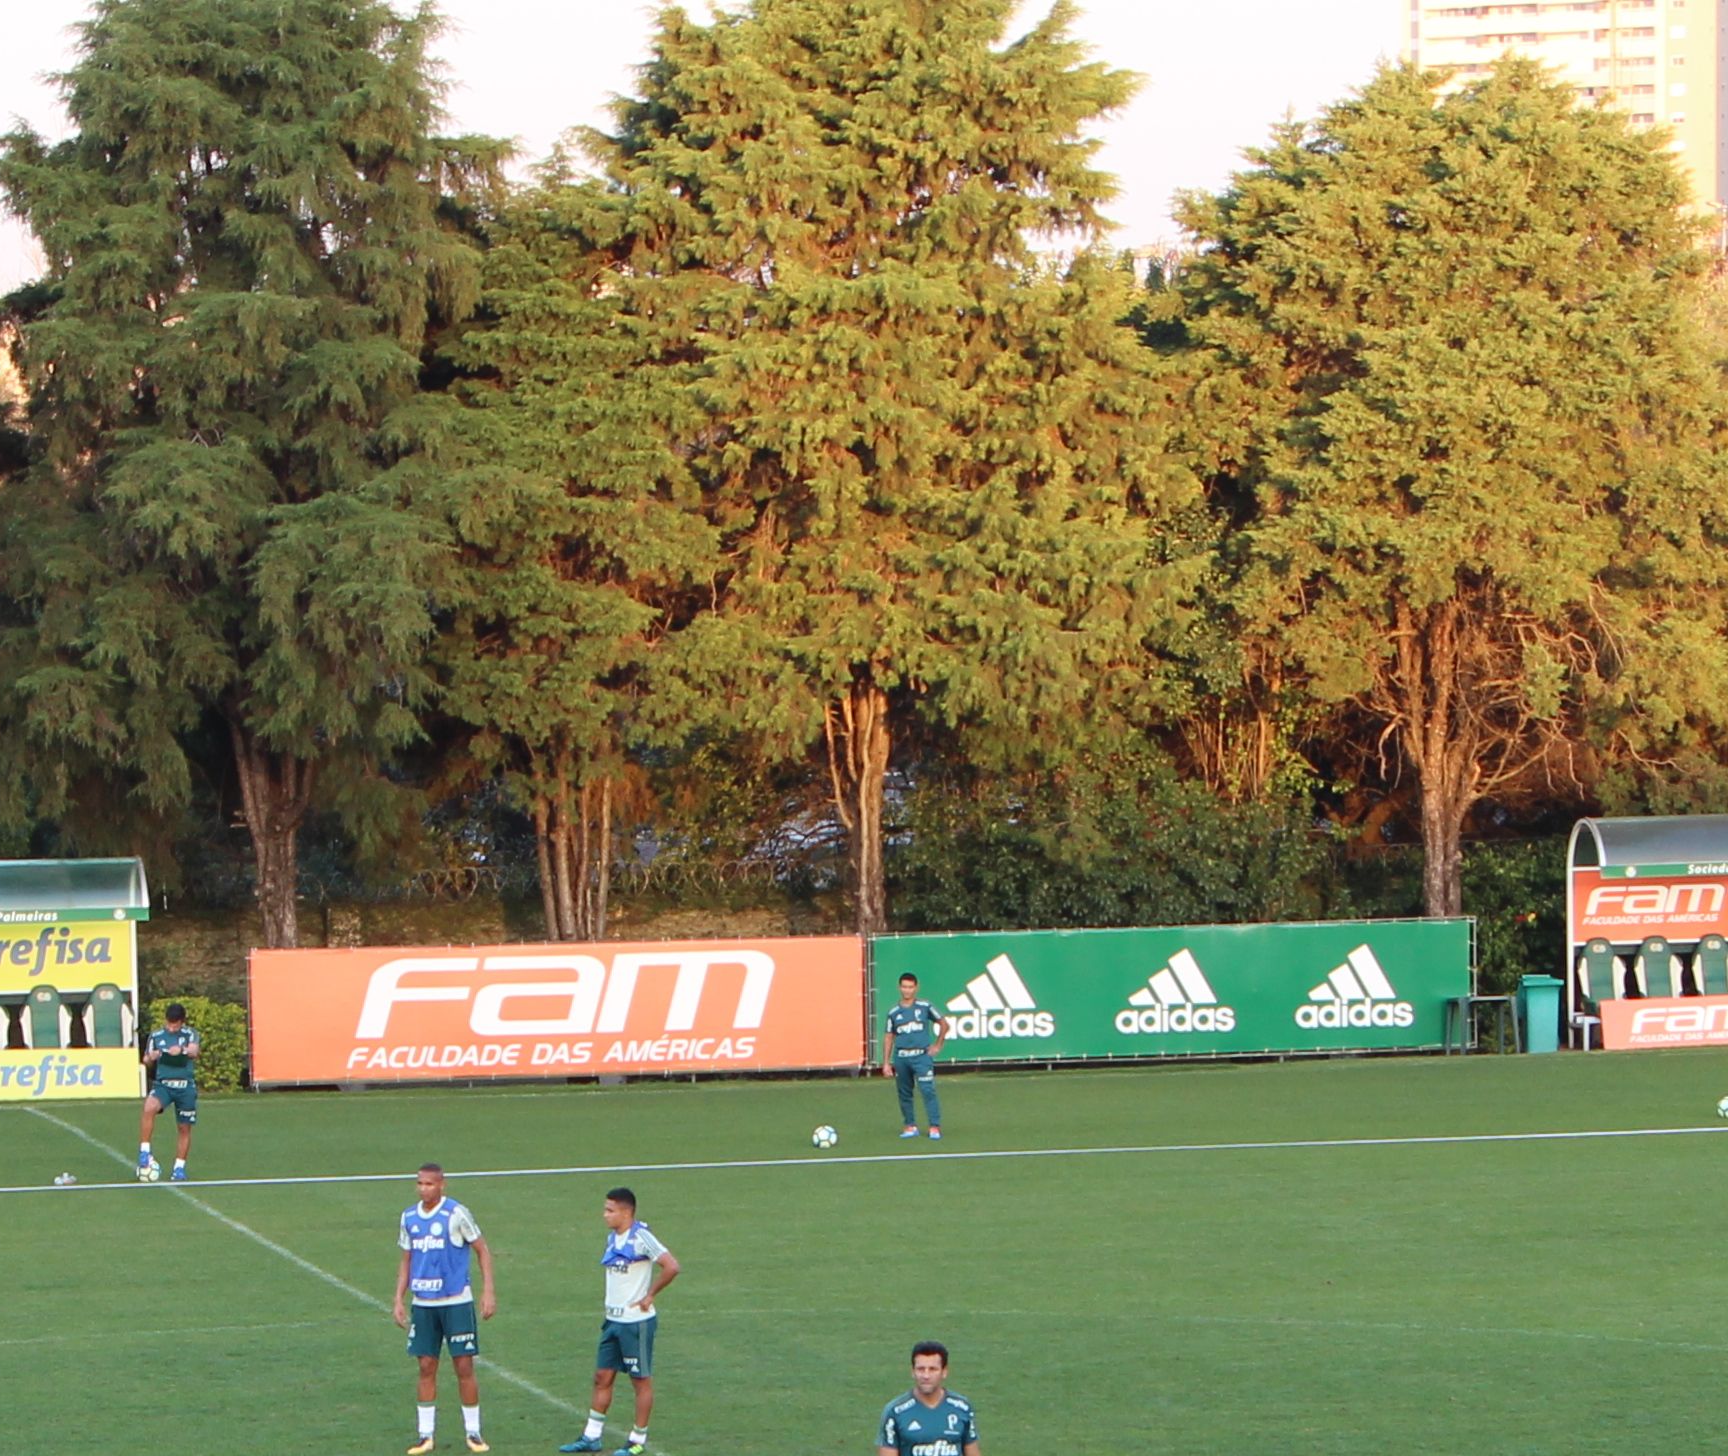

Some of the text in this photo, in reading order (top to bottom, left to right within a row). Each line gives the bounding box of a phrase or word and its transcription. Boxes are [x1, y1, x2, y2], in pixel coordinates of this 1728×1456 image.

[1643, 915, 1665, 924] DAS
[1115, 1003, 1237, 1034] adidas
[1294, 998, 1415, 1030] adidas
[346, 1033, 756, 1069] FACULDADE DAS AMÉRICAS
